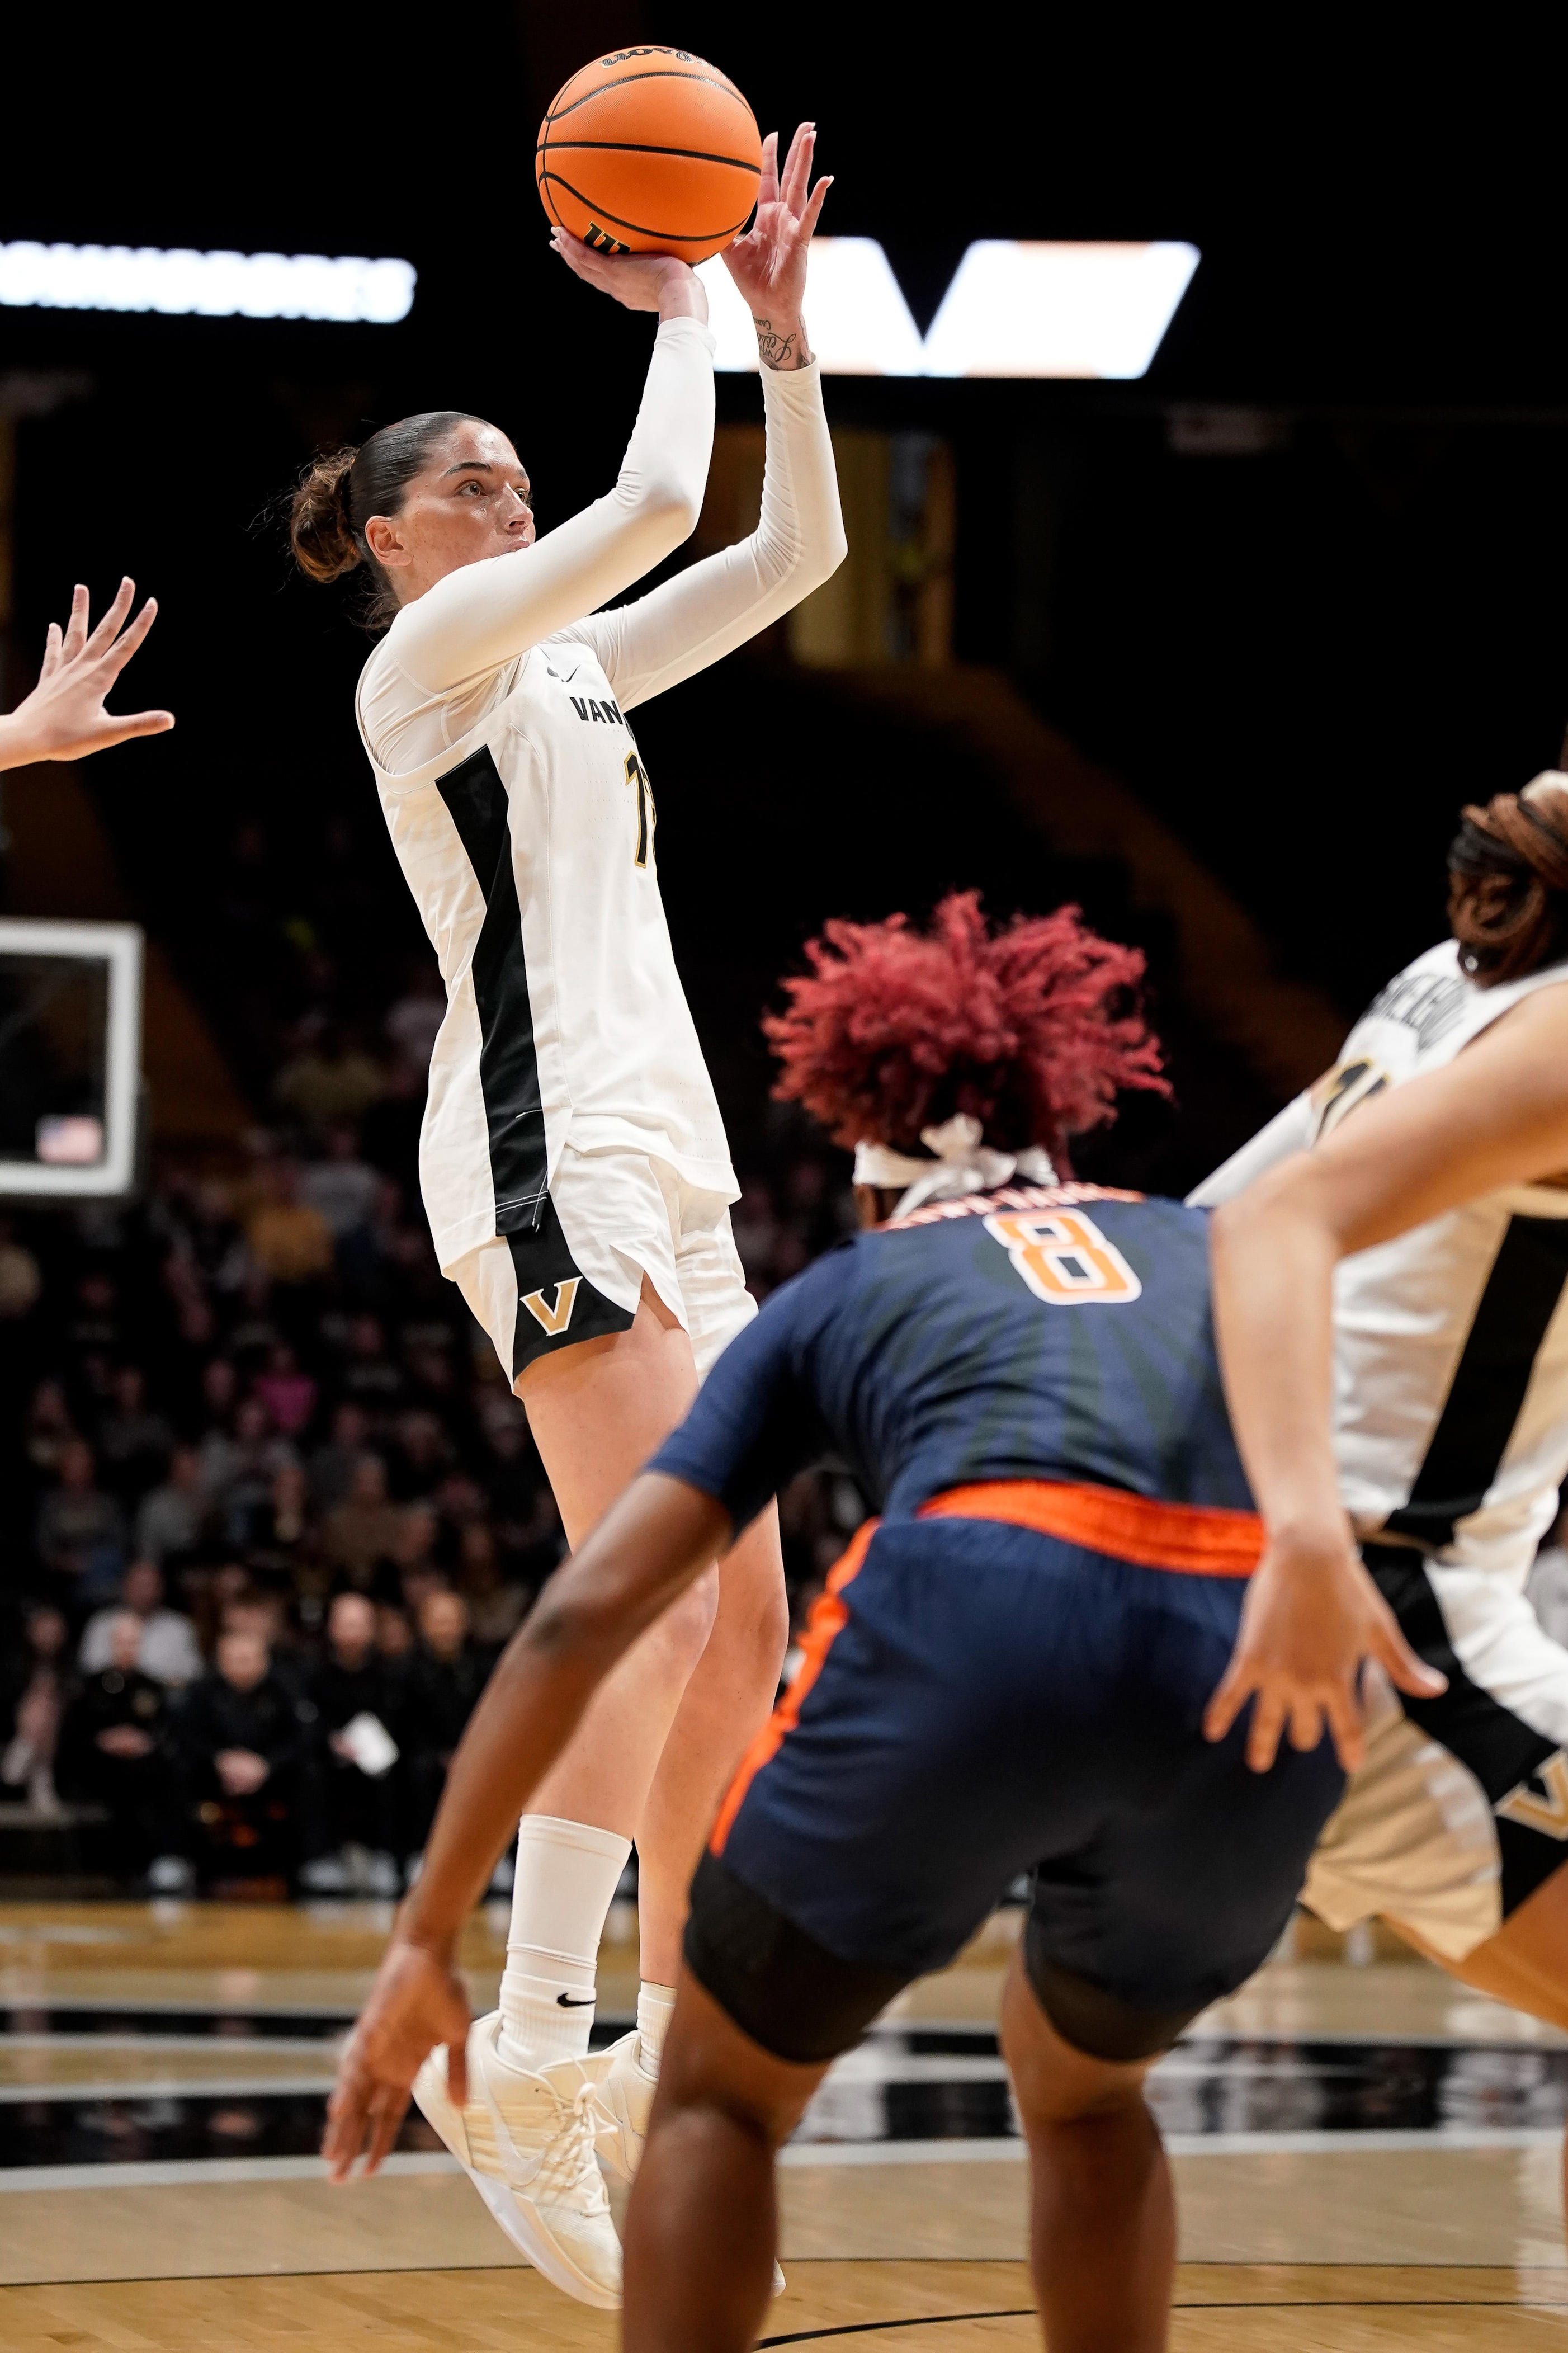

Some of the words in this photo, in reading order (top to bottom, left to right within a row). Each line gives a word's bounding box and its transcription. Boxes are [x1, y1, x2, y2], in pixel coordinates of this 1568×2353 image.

[569, 696, 635, 743] VAN
[624, 750, 657, 869] 1
[983, 1206, 1143, 1305] 8
[519, 1275, 583, 1337] V
